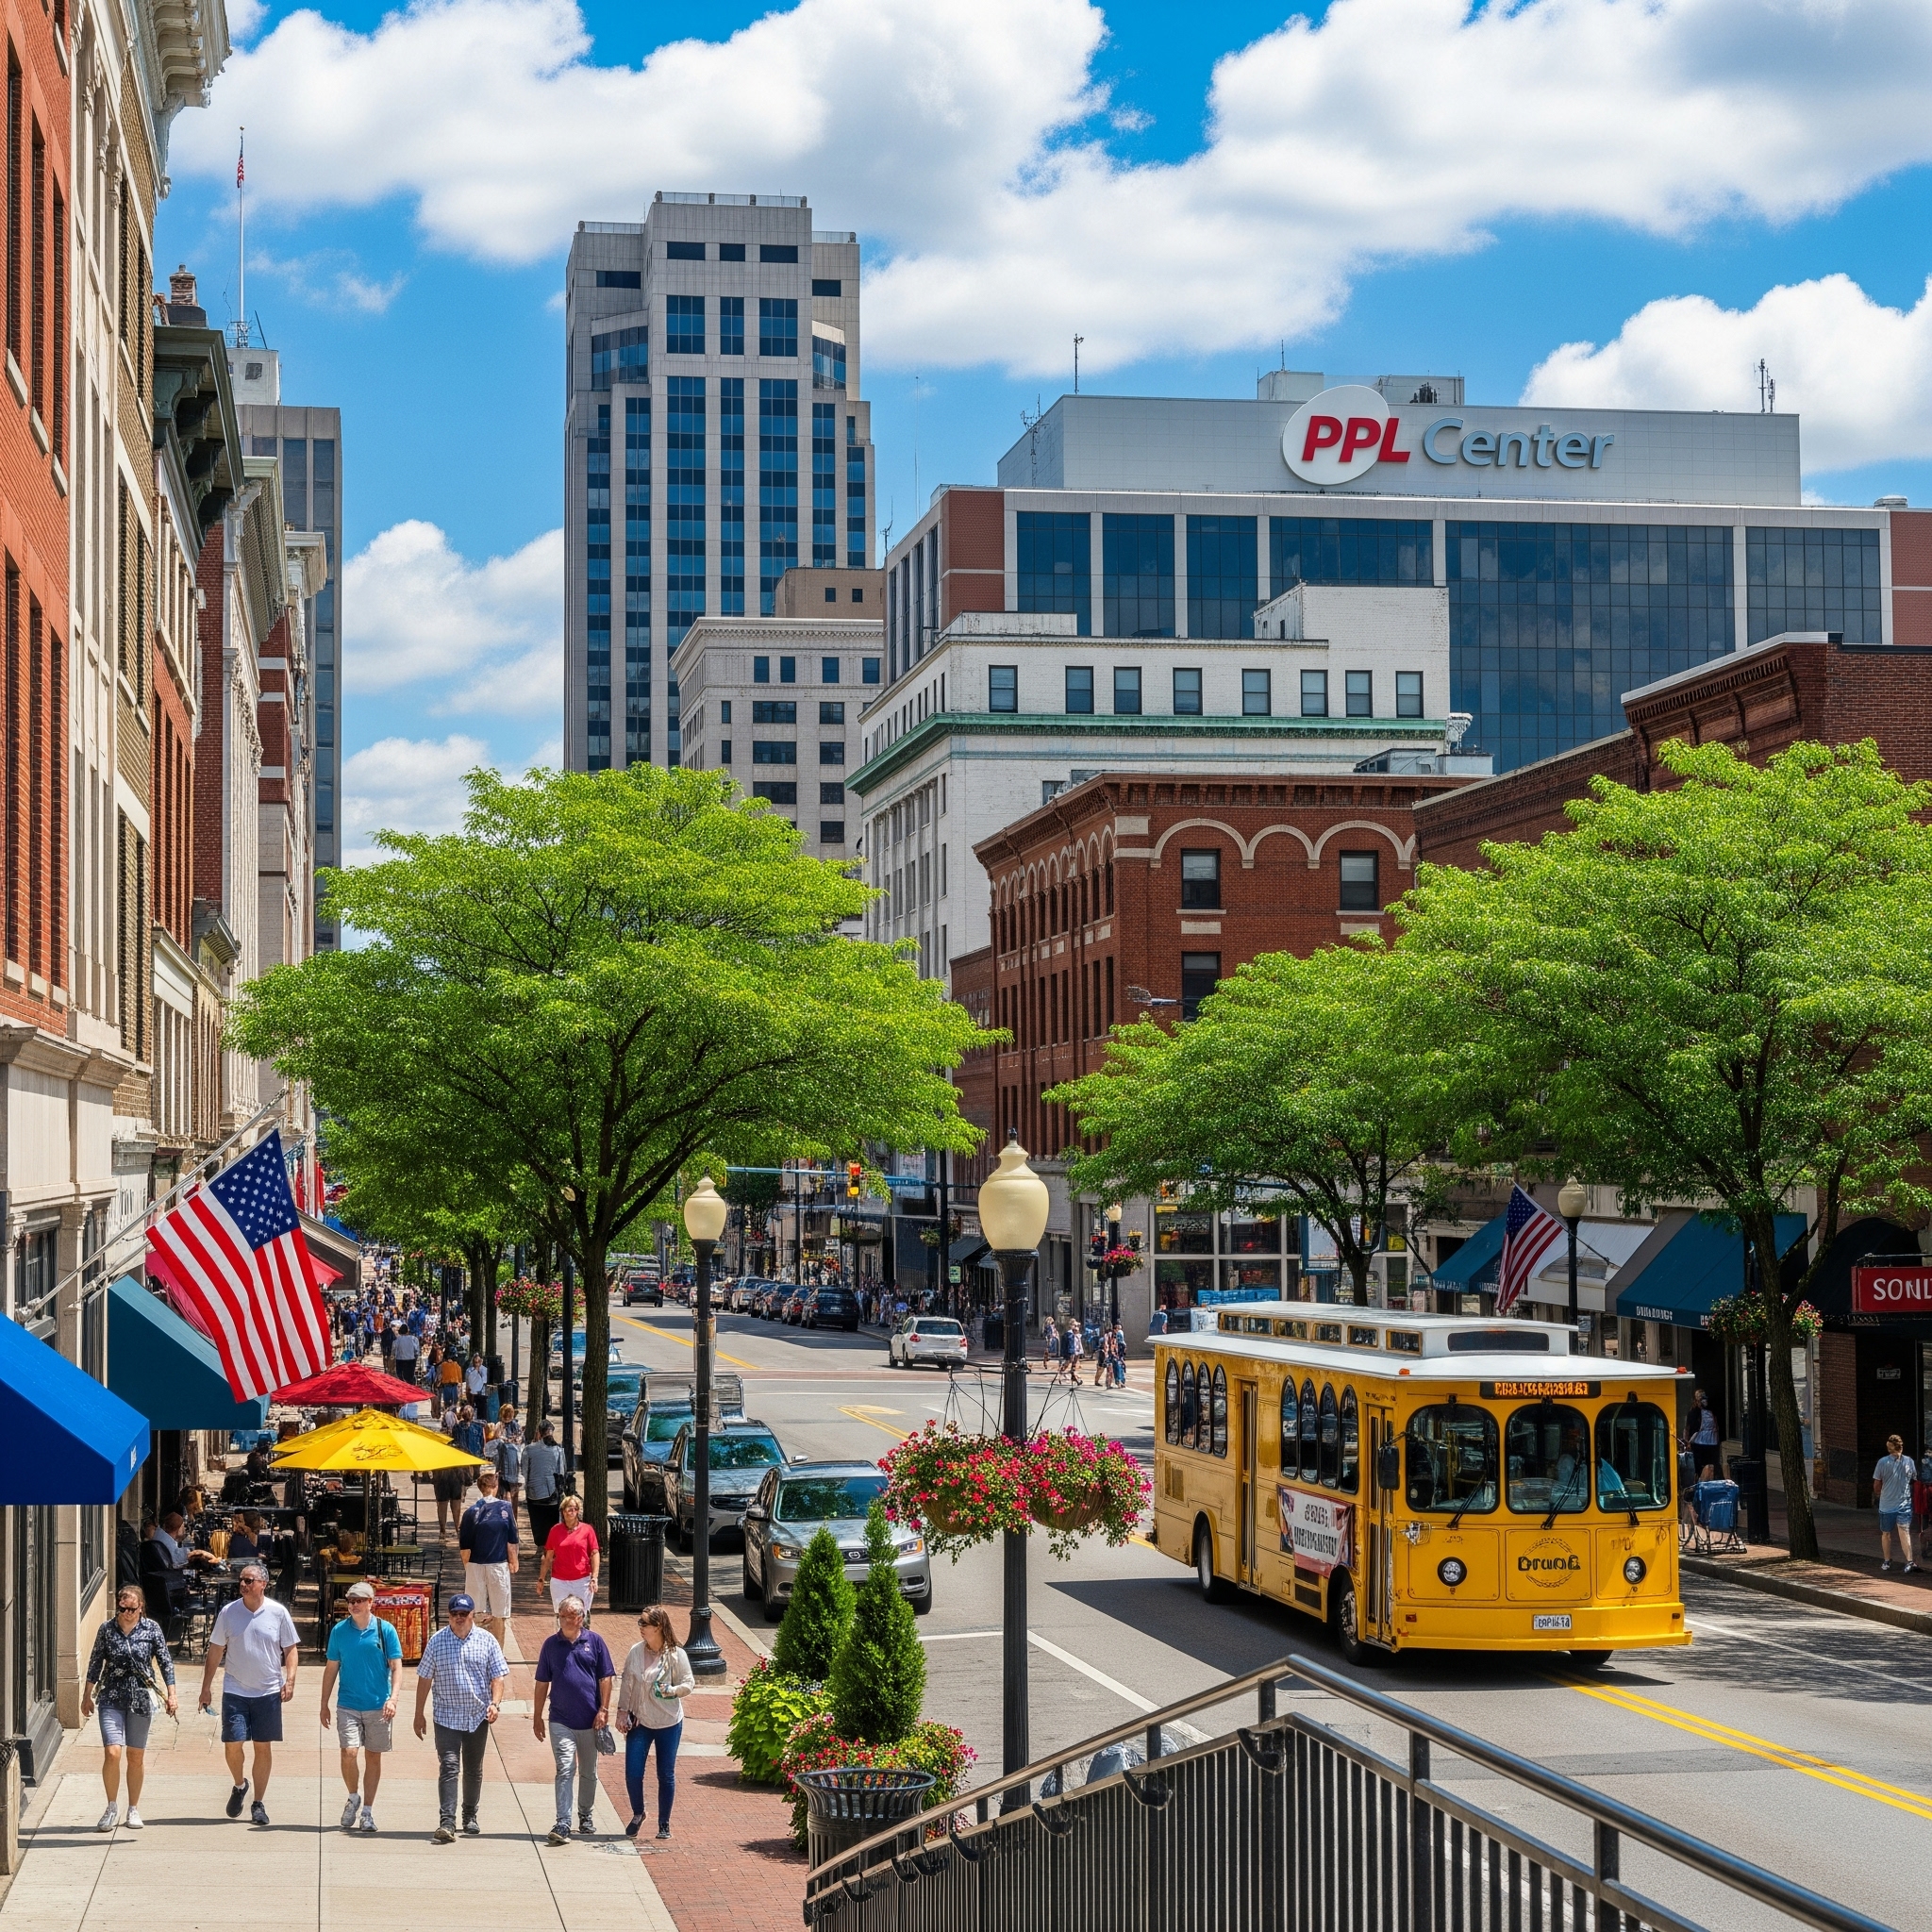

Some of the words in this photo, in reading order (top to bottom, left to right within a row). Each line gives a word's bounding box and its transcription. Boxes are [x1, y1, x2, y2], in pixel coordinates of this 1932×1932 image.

[1302, 415, 1410, 462] PPL
[1423, 417, 1614, 468] Center
[1874, 1278, 1932, 1300] SONL
